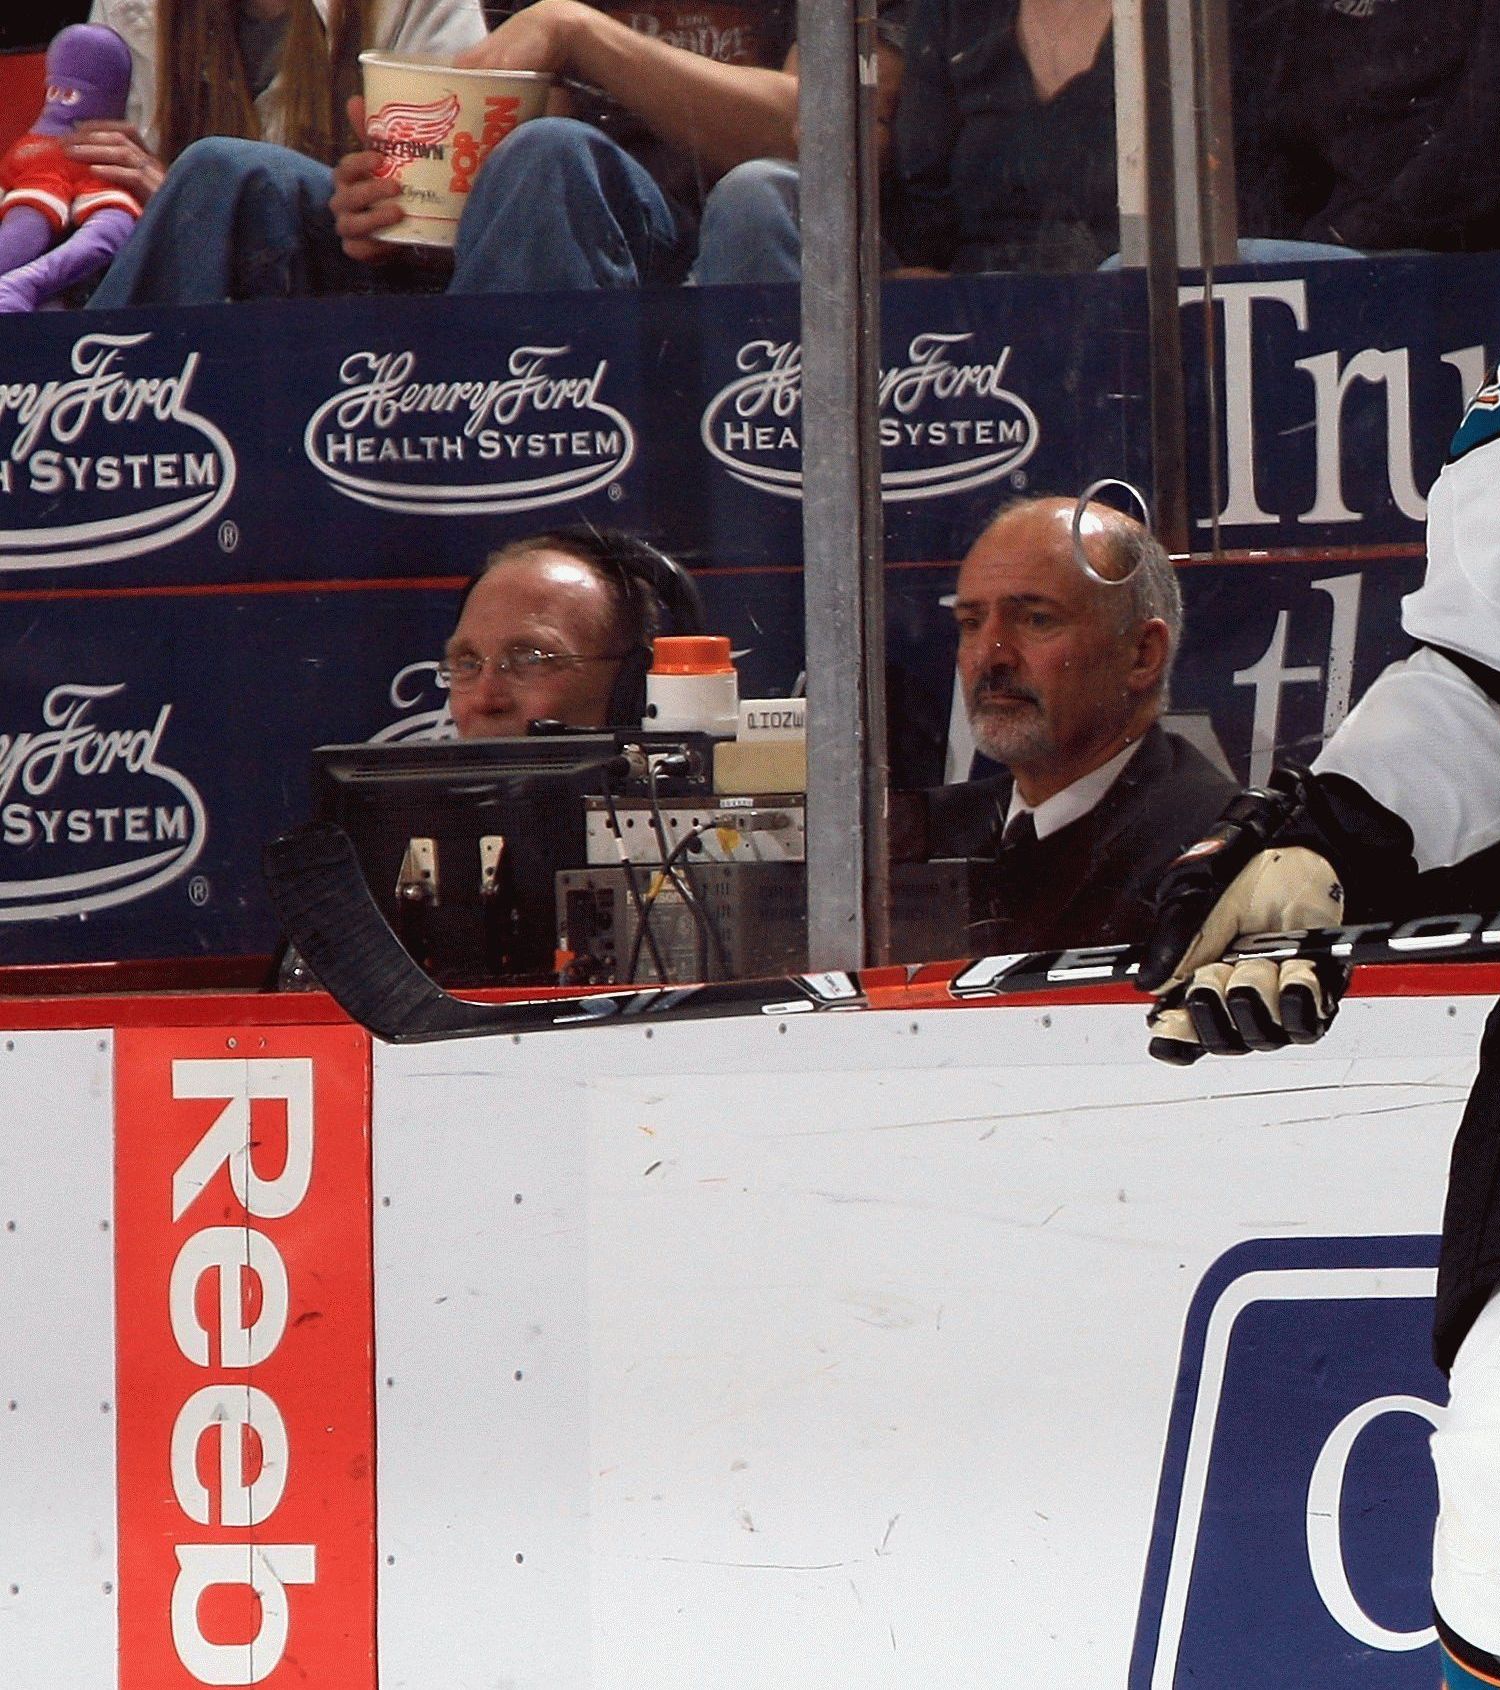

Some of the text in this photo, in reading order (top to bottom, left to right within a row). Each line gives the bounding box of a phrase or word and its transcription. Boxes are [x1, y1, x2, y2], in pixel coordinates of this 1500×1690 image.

[449, 132, 480, 193] POP
[479, 96, 521, 163] RN
[51, 332, 200, 443] Ford
[337, 346, 608, 438] Henry Ford
[894, 332, 1011, 413] Ford
[326, 429, 620, 462] HEALTH SYSTEM
[723, 418, 1026, 451] HEA SYSTEM
[29, 450, 217, 493] SYSTEM
[22, 683, 173, 796] Ford
[3, 804, 188, 845] SYSTEM
[169, 1057, 317, 1687] Reeb
